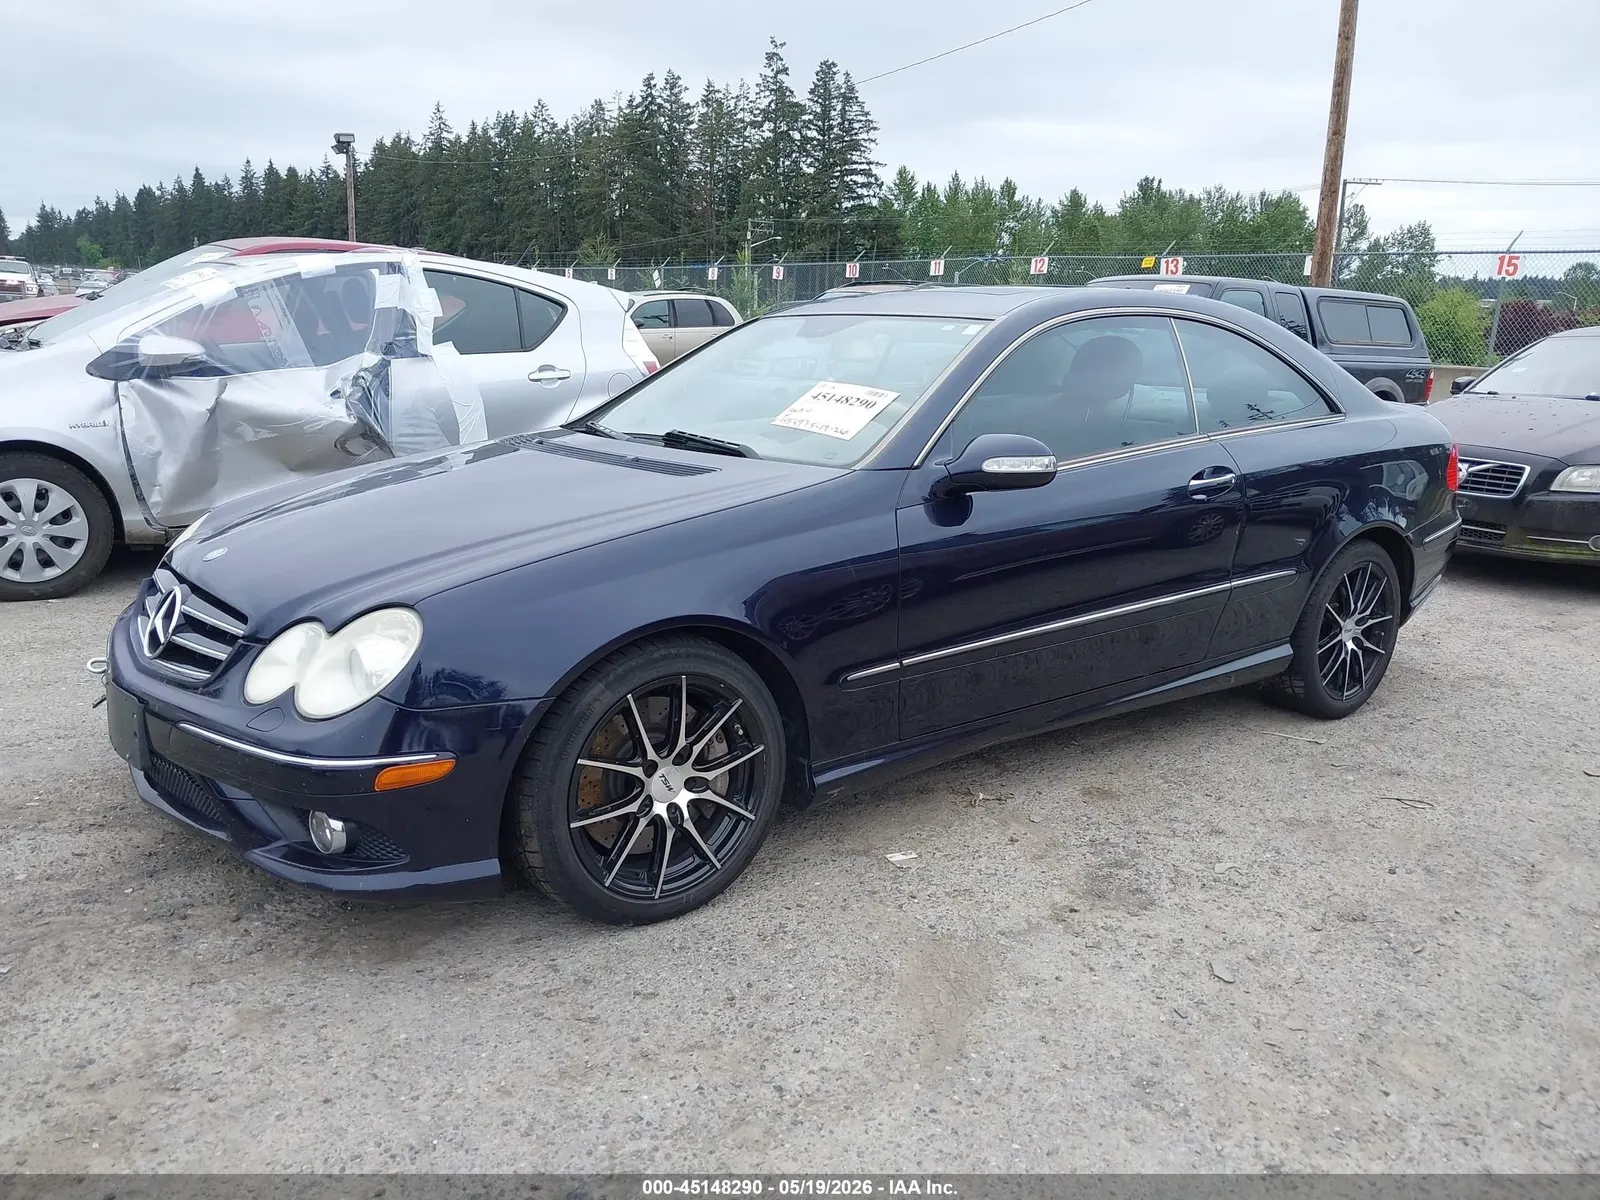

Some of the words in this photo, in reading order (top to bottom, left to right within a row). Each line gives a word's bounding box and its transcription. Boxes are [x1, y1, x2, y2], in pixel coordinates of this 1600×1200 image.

[775, 267, 781, 279] 9
[848, 263, 857, 277] 10
[933, 260, 942, 275] 11
[1033, 258, 1046, 273] 12
[1163, 258, 1180, 276] 13
[1496, 254, 1520, 277] 15
[811, 392, 877, 409] 45148290
[68, 421, 104, 430] HYBRID
[658, 773, 676, 793] TSW
